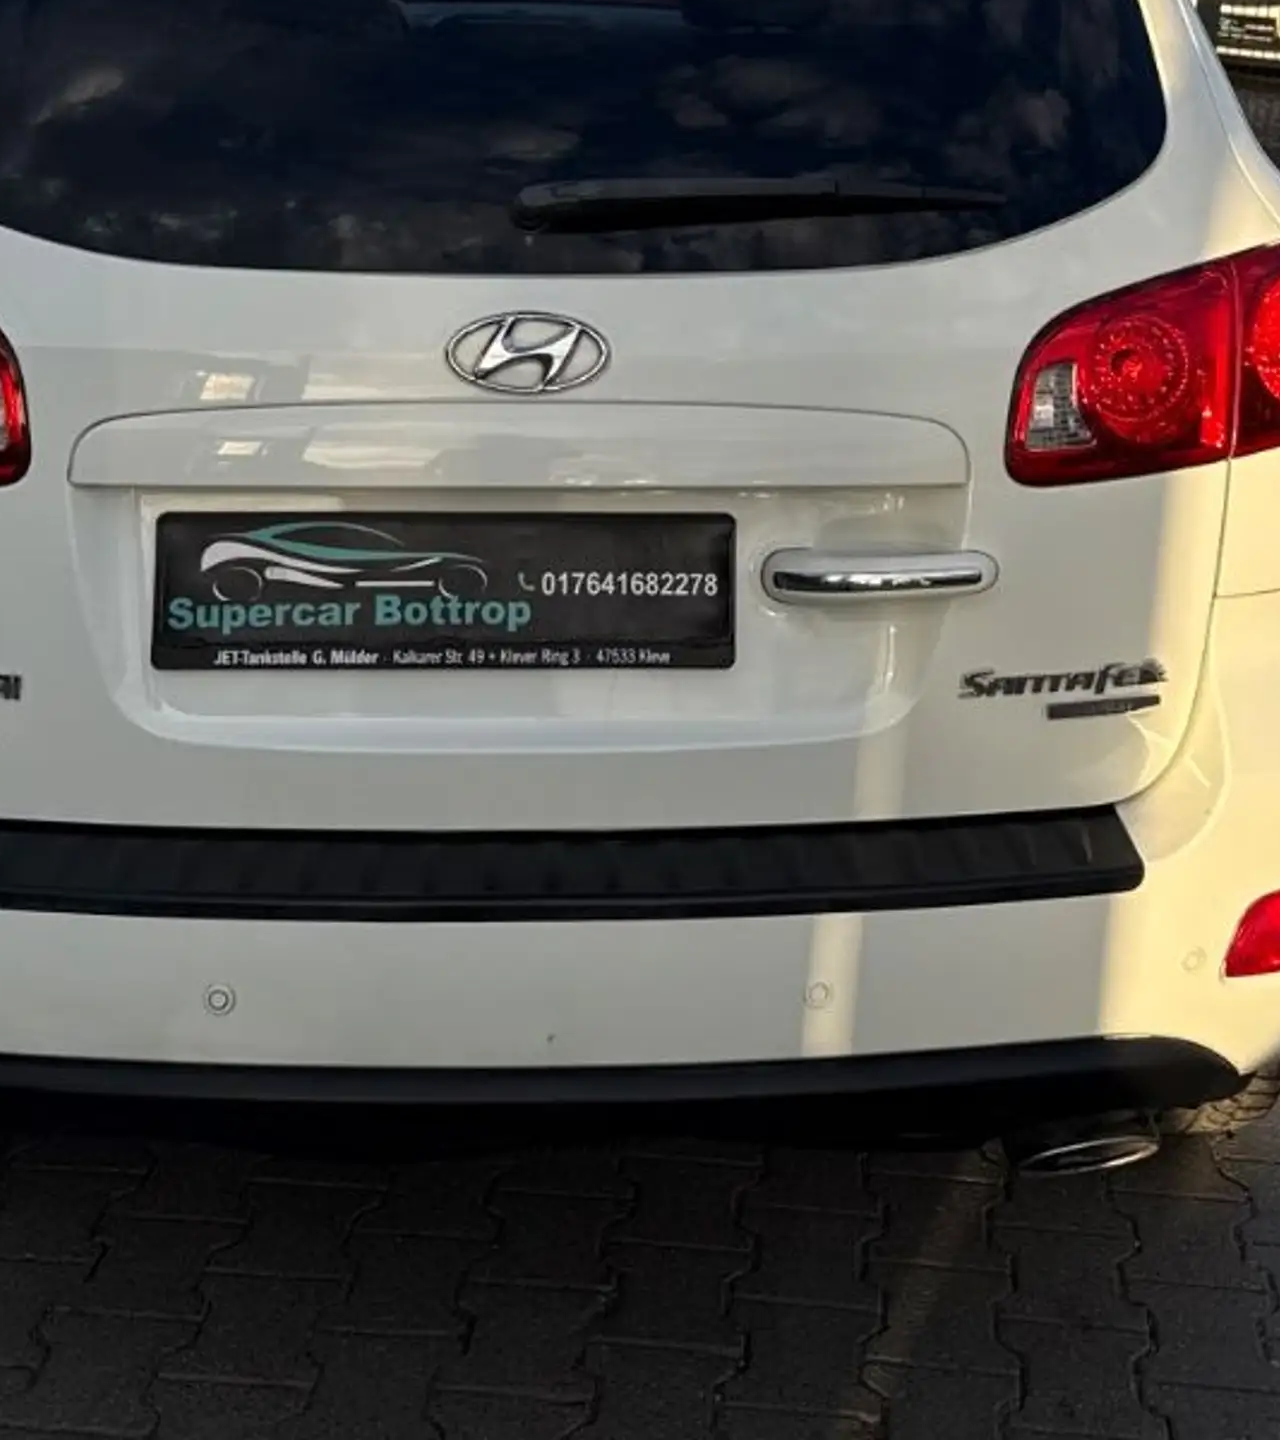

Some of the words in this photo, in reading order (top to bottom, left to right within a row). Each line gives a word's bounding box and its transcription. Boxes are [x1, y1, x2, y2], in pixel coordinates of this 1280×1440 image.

[540, 571, 718, 596] 017641682278
[167, 594, 360, 634] Supercar
[374, 594, 532, 633] Bottrop
